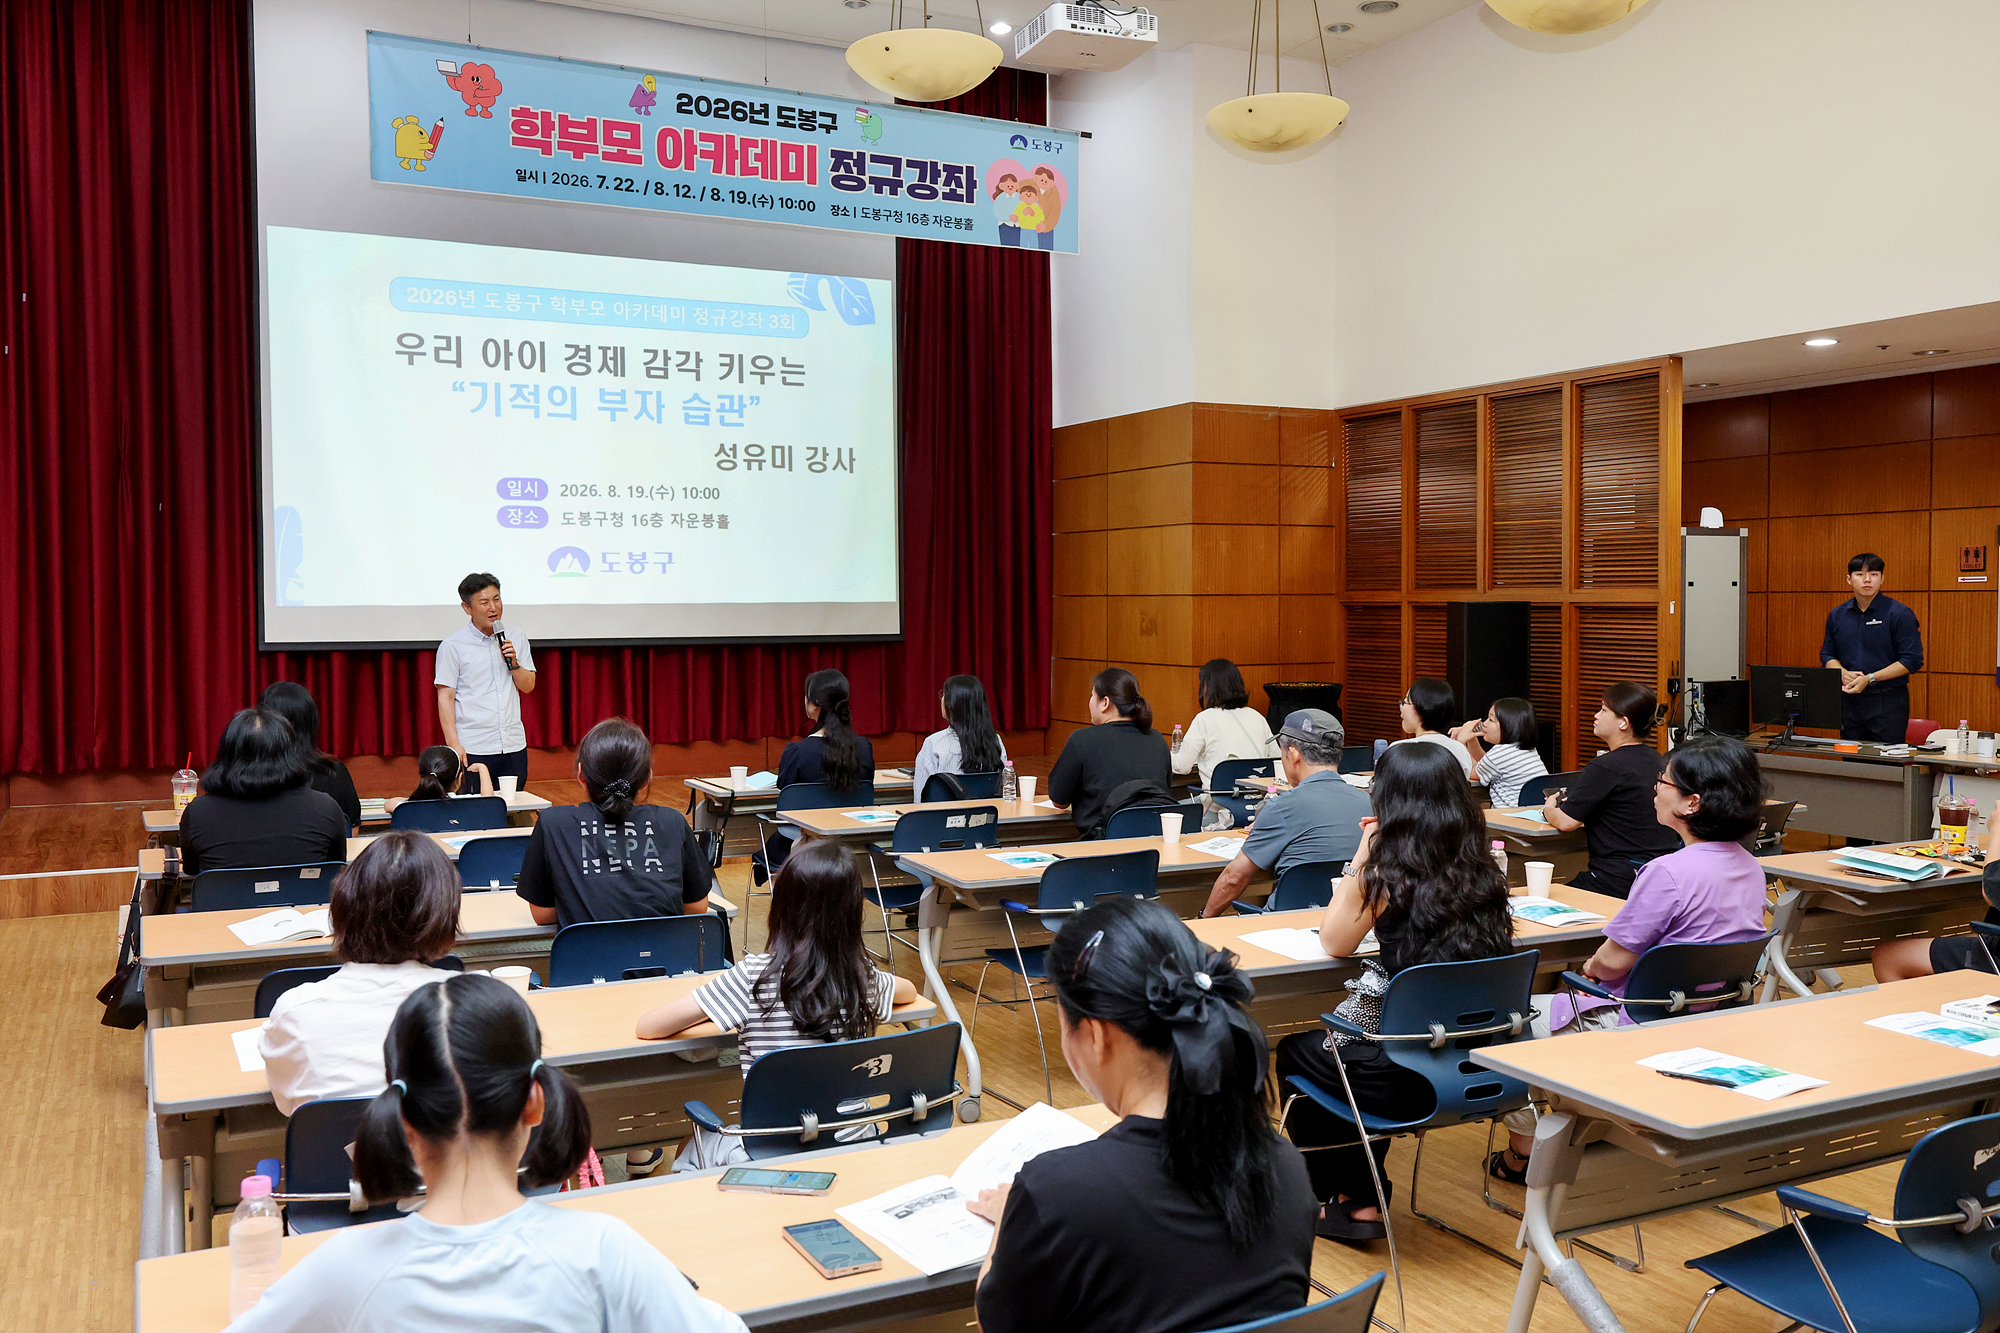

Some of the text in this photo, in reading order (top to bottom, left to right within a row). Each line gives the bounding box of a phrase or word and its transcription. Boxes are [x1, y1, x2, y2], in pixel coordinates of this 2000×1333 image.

[675, 92, 838, 134] 2026년 도봉구
[509, 106, 979, 205] 학부모 아카데미 정규강좌
[1031, 138, 1064, 154] 도봉구
[515, 168, 538, 183] 일시
[551, 172, 593, 188] 2026.
[596, 174, 609, 190] 7.
[613, 176, 639, 193] 22.
[778, 196, 816, 212] 10:00
[830, 204, 851, 217] 장소
[860, 206, 903, 224] 도봉구청
[906, 212, 930, 226] 16층
[932, 214, 975, 231] 자운봉홀
[406, 286, 796, 332] 2026년 도봉구 학부모 아카데미 정규강좌 3회
[395, 332, 806, 387] 우리 아이 경제 감각 키우는
[597, 386, 666, 425] 부자
[713, 442, 857, 474] 성유미 강사
[506, 480, 539, 498] 일시
[560, 483, 602, 499] 2026.
[607, 484, 621, 500] 8.
[681, 486, 720, 501] 10:00
[506, 507, 731, 530] 장소 도봉구청 16층 자운봉홀
[600, 551, 675, 575] 도봉구
